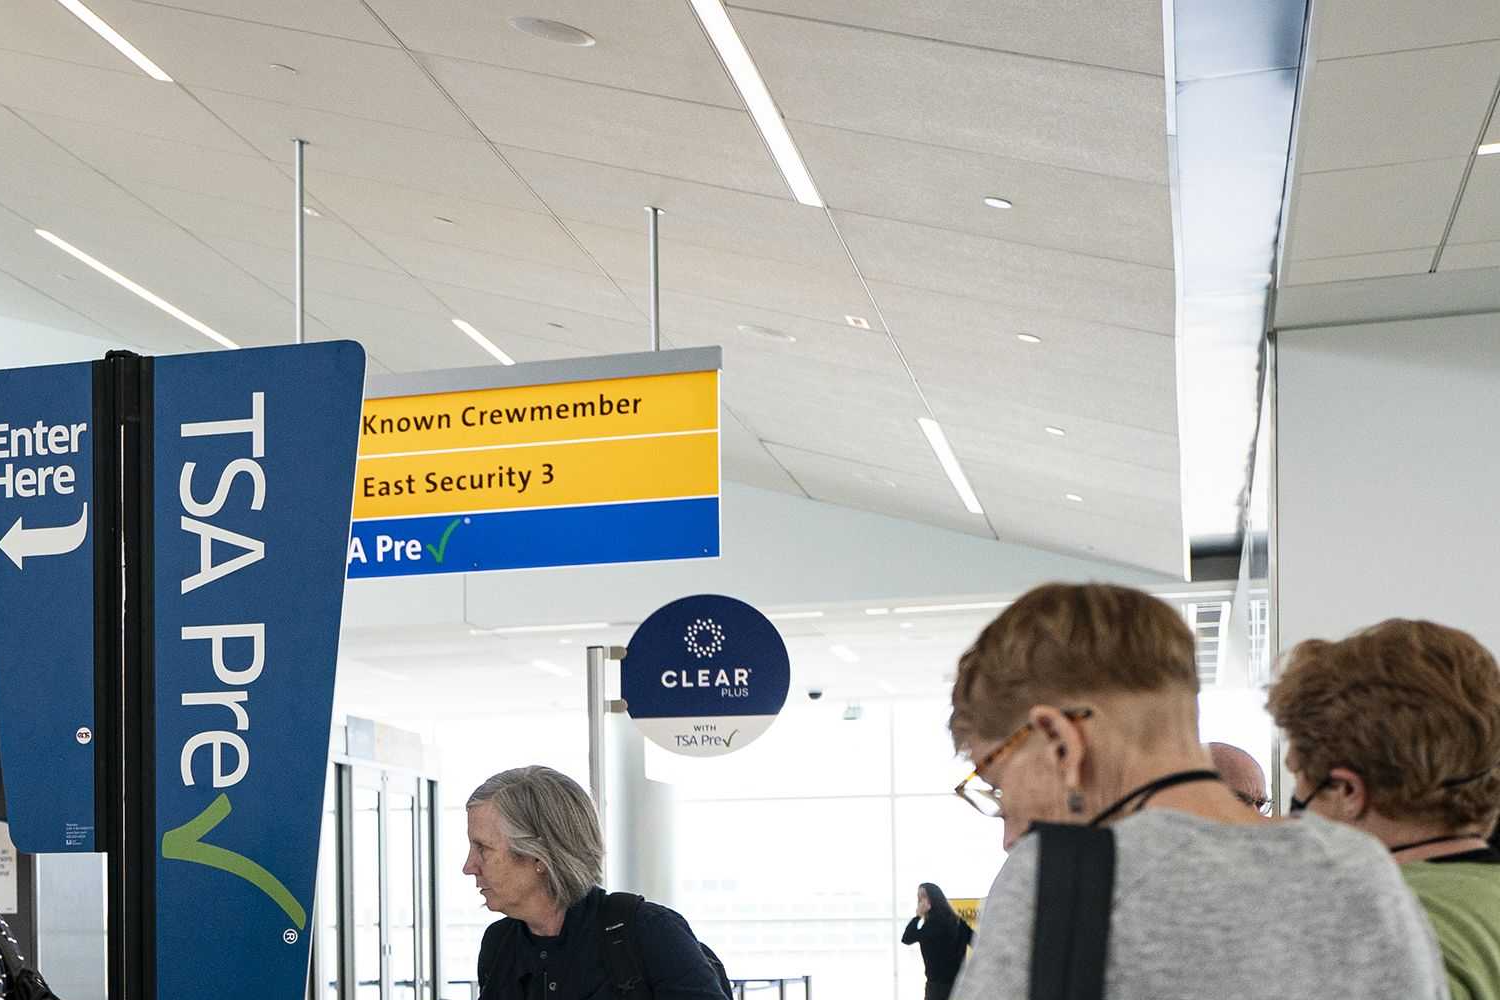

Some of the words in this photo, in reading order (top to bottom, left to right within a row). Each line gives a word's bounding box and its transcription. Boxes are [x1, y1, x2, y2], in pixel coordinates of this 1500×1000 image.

[362, 412, 451, 435] Known
[461, 394, 642, 428] Crewmember
[179, 391, 266, 595] TSA
[363, 474, 416, 497] East
[425, 466, 532, 493] Security
[542, 463, 555, 484] 3
[376, 534, 422, 563] Pre
[661, 668, 749, 688] CLEAR
[721, 688, 749, 697] PLUS
[180, 623, 266, 789] Pre
[675, 735, 698, 746] TSA
[701, 735, 722, 746] Pre
